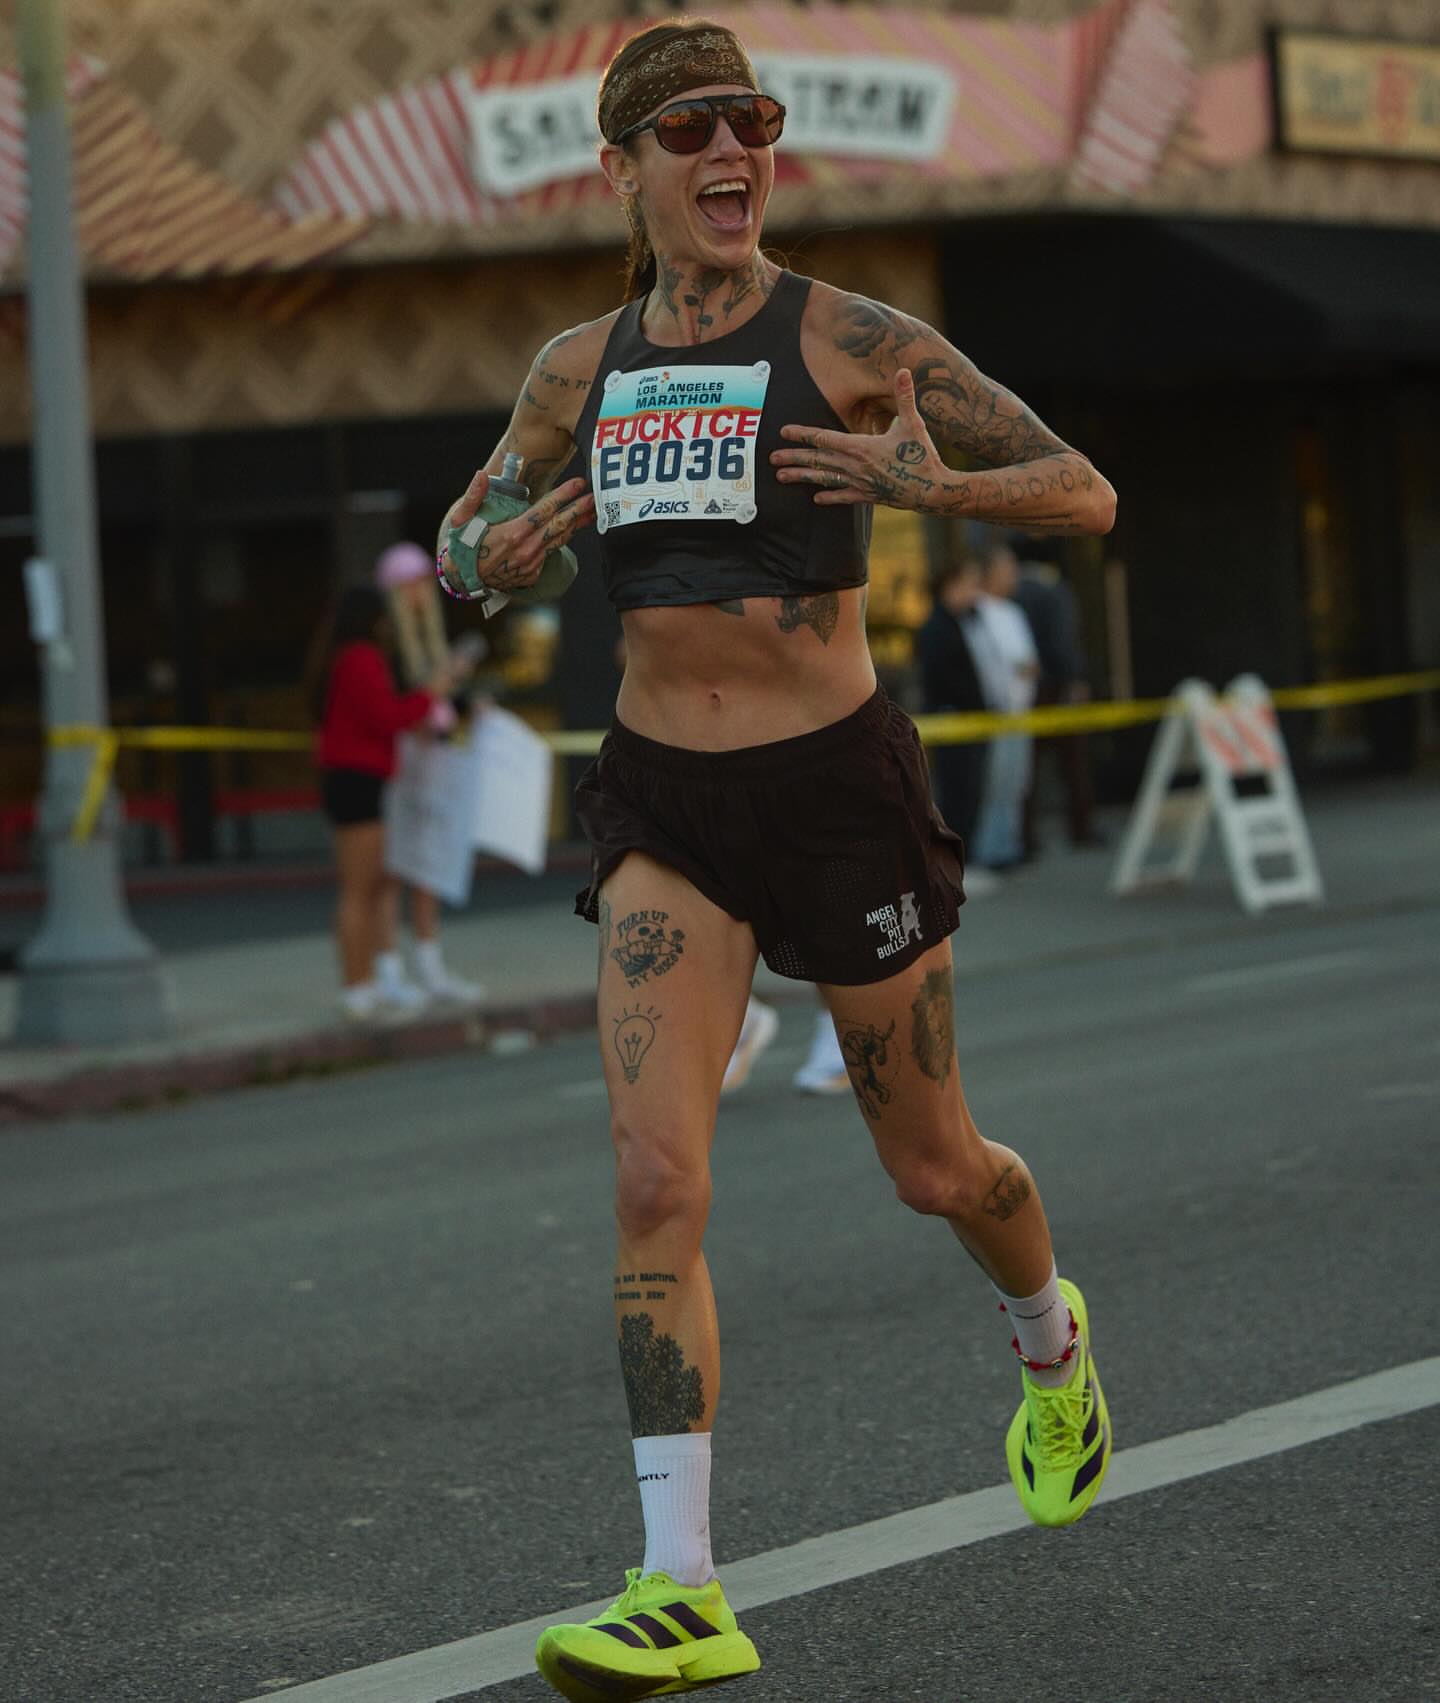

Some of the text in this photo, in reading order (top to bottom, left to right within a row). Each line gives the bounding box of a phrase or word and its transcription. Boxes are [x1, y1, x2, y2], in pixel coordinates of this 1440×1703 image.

[490, 98, 602, 168] SAL
[637, 382, 725, 397] LOS ANGELES
[635, 393, 723, 409] MARATHON
[600, 437, 746, 491] E8036
[651, 910, 669, 924] UP
[866, 904, 896, 926] ANGEL
[880, 912, 898, 933] CITY
[888, 925, 902, 942] PIT
[877, 936, 905, 960] BULLS
